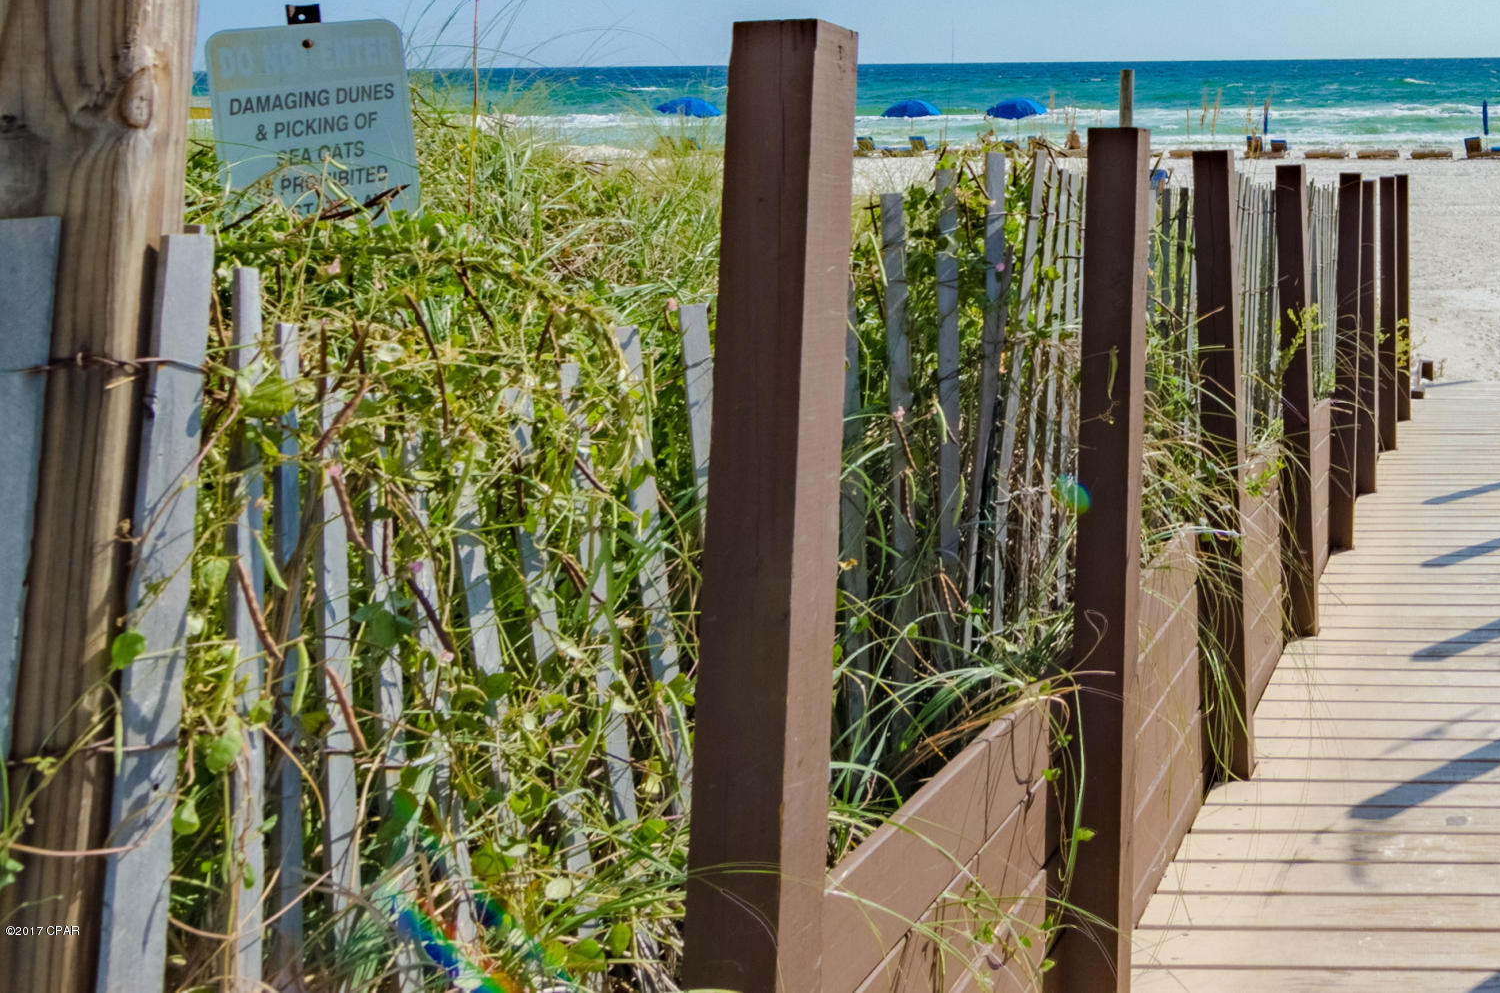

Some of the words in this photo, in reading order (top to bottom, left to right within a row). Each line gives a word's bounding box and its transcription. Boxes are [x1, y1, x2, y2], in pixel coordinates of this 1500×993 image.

[219, 47, 254, 79] DO
[229, 90, 330, 116] DAMAGING
[335, 83, 395, 105] DUNES
[255, 124, 268, 142] &
[274, 117, 349, 139] PICKING
[354, 112, 378, 130] OF
[277, 148, 312, 167] SEA
